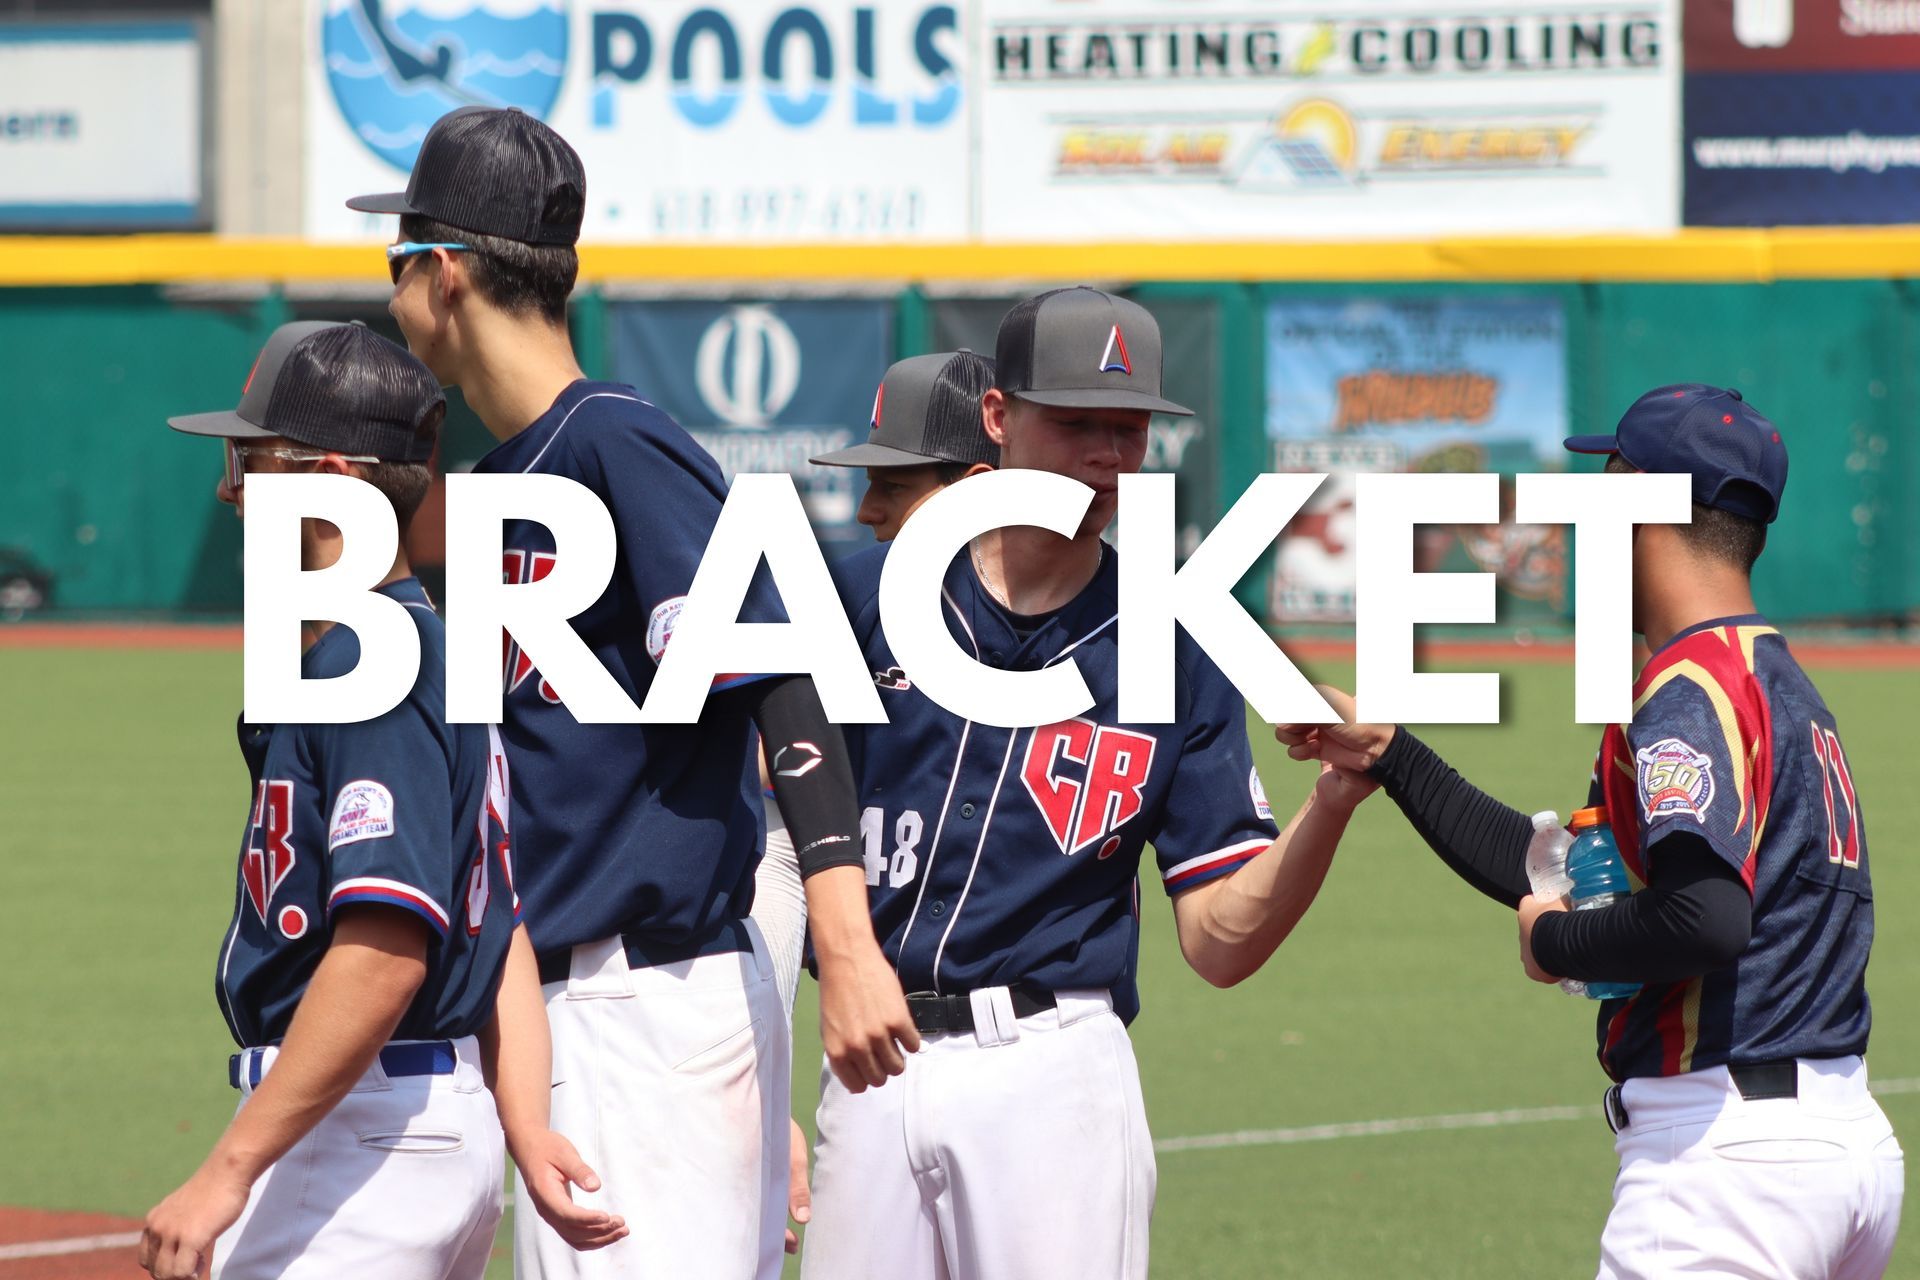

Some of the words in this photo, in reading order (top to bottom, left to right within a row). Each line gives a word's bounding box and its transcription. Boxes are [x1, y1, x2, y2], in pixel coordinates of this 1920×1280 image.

[591, 6, 961, 128] POOLS
[995, 31, 1281, 73] HEATING
[1350, 20, 1659, 73] COOLING
[1058, 128, 1229, 168] SOLAR
[1380, 120, 1591, 166] ENERGY
[1019, 715, 1157, 856] CR
[1647, 761, 1702, 795] 50
[364, 823, 389, 833] TEAM
[860, 806, 924, 889] 48
